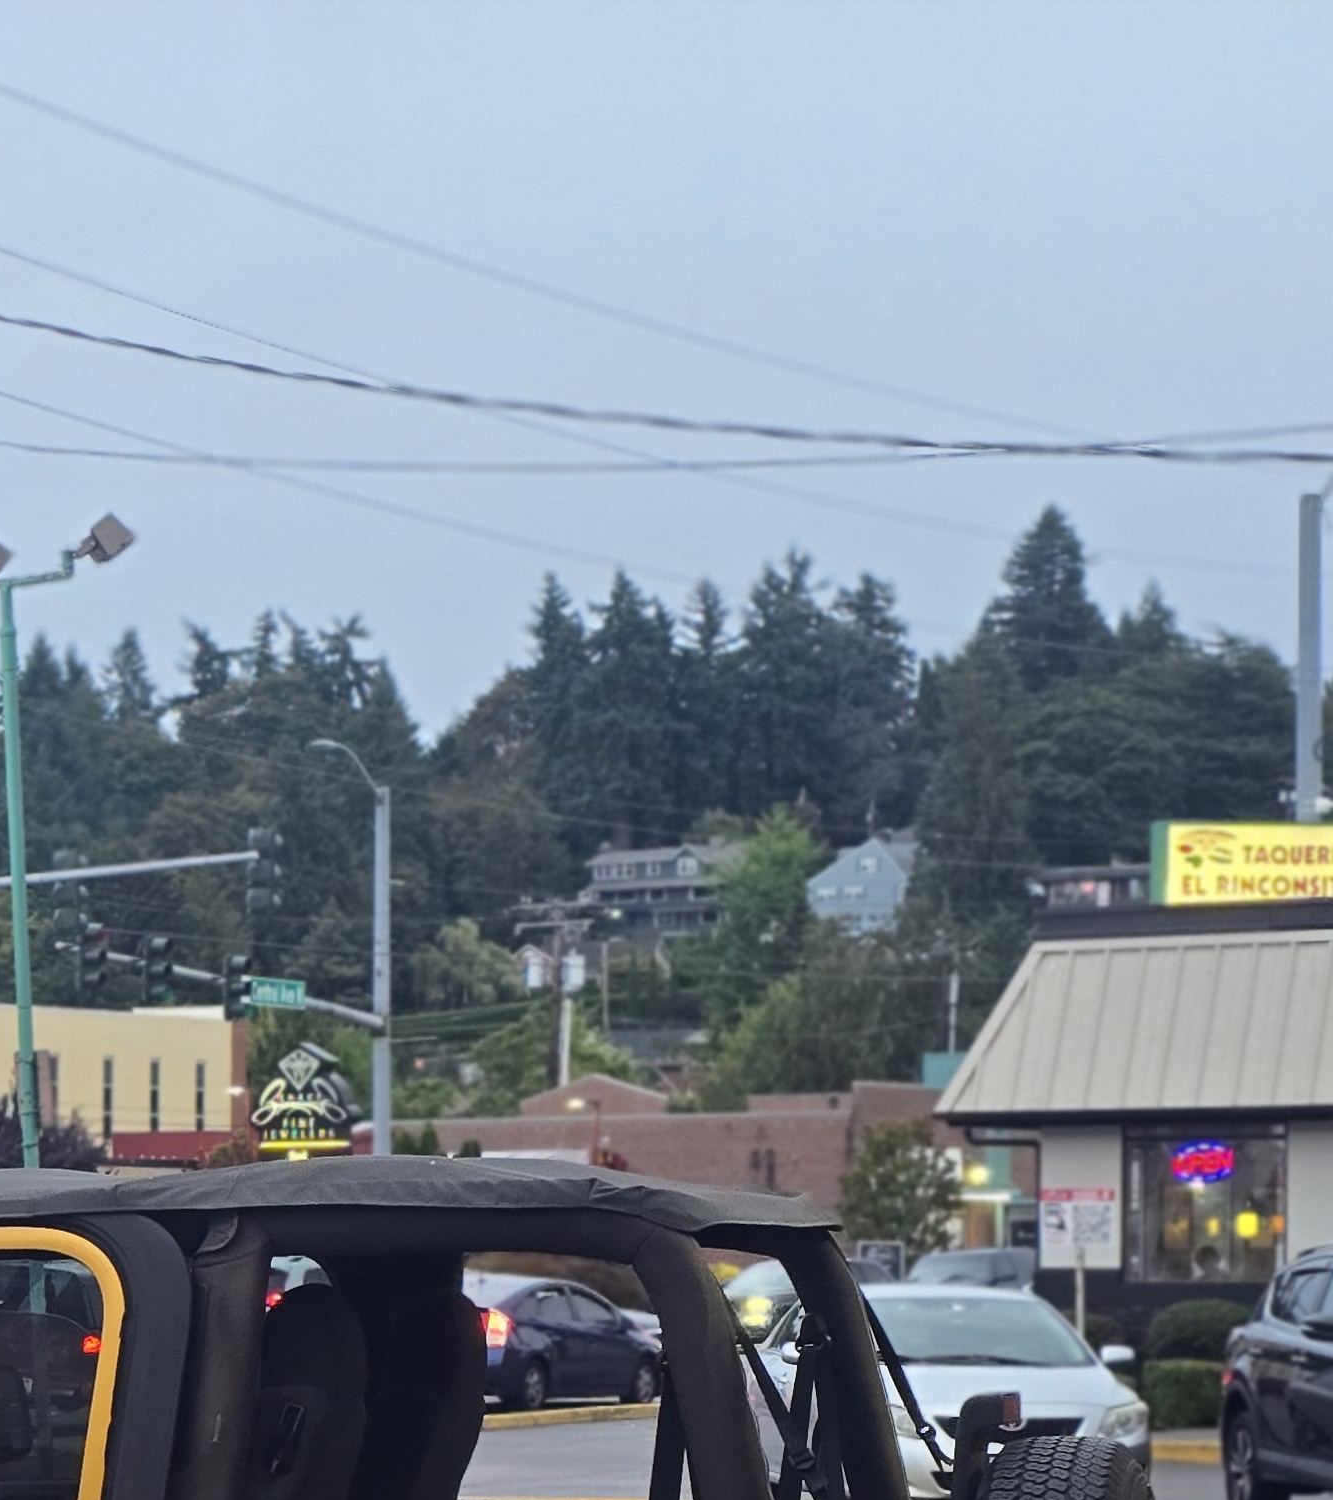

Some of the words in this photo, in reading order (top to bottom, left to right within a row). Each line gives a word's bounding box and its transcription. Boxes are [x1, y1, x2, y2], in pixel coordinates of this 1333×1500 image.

[1243, 845, 1333, 865] TAQUER
[1182, 875, 1206, 896] EL
[1217, 875, 1333, 896] RINCONSI
